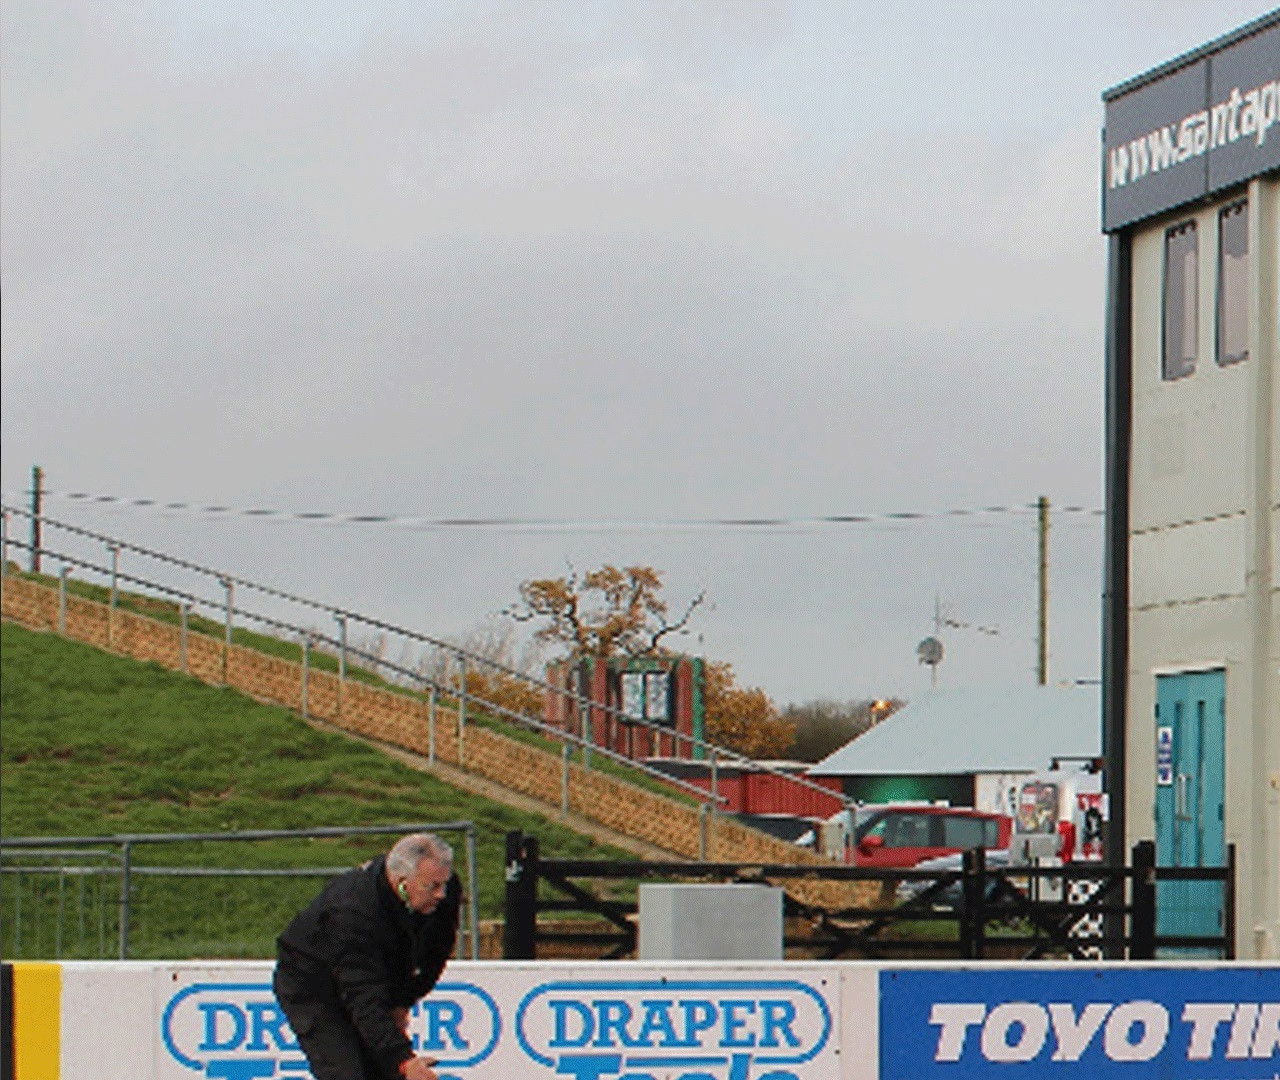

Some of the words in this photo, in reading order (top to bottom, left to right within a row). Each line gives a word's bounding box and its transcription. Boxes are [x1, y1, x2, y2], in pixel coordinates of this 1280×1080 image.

[197, 1000, 470, 1051] DRR
[547, 999, 801, 1048] DRAPER
[929, 1000, 1170, 1062] TOYO
